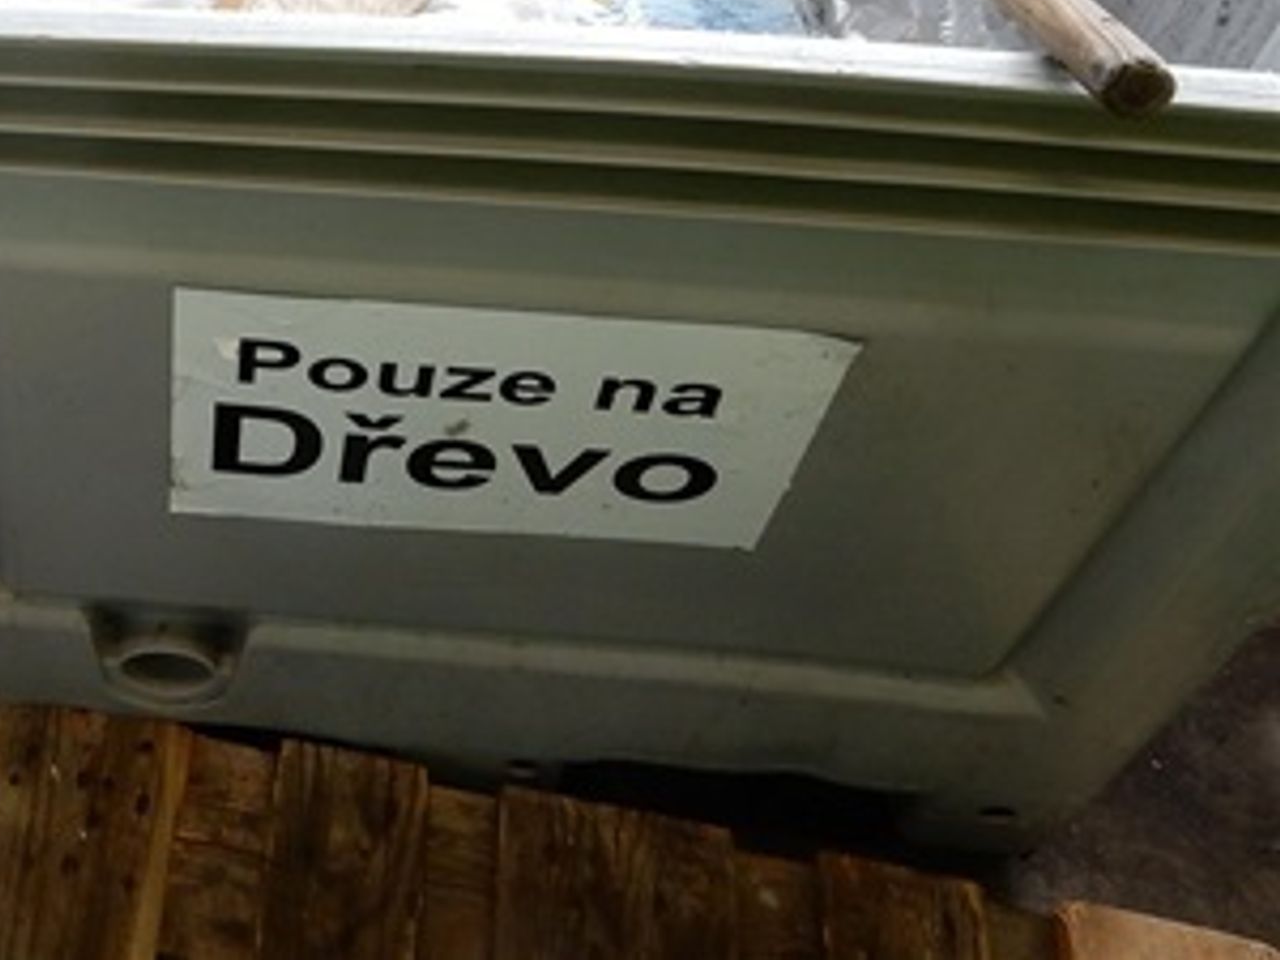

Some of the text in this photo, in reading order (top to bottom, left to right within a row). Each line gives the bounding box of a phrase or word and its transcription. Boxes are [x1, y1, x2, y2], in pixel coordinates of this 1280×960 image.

[237, 338, 722, 417] Pouze na
[212, 403, 719, 503] Dřevo
